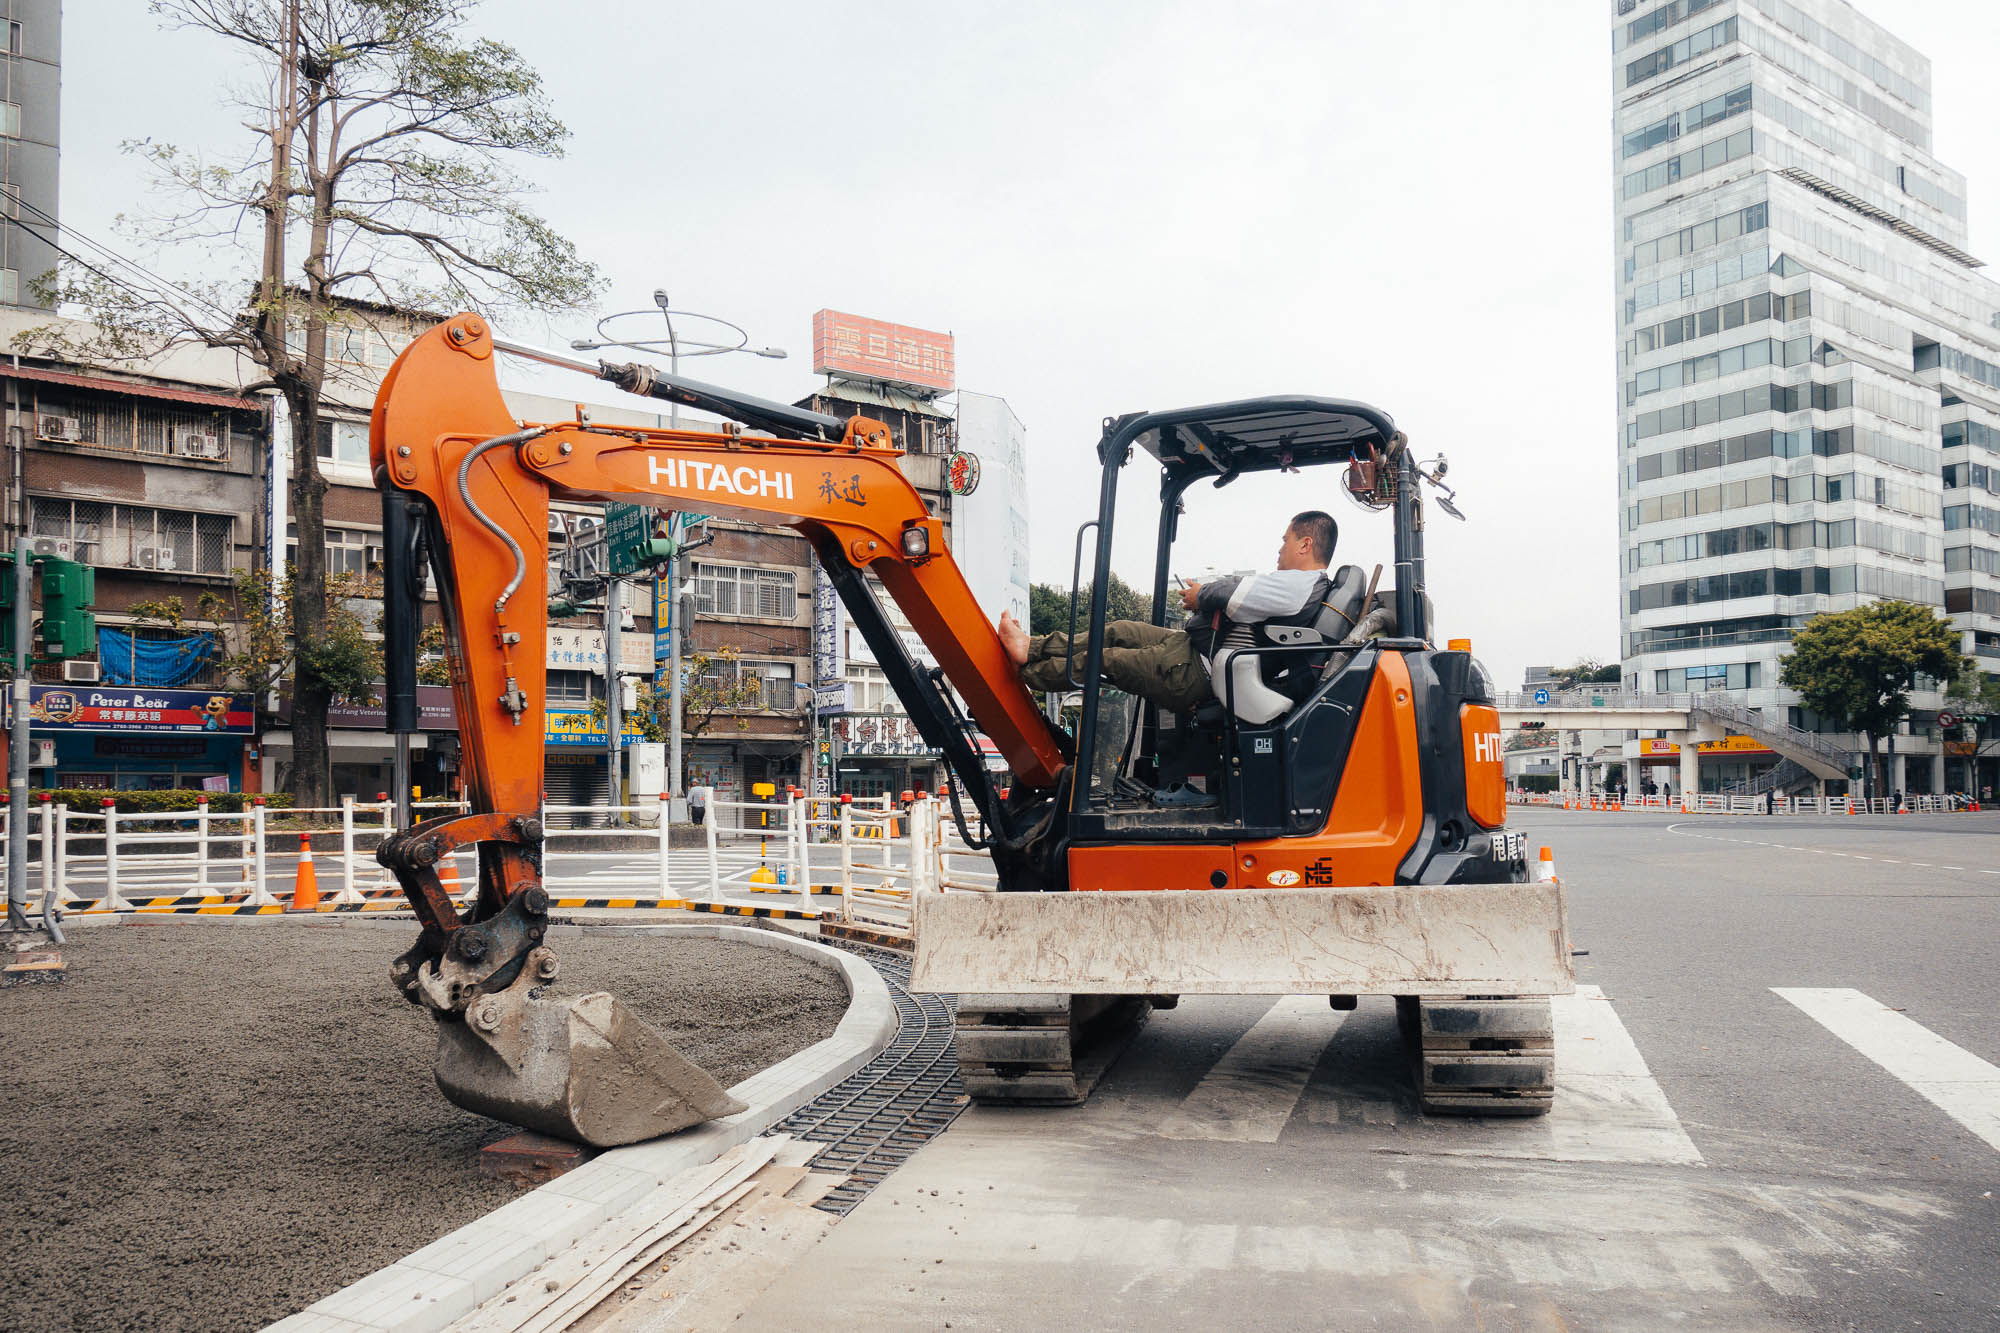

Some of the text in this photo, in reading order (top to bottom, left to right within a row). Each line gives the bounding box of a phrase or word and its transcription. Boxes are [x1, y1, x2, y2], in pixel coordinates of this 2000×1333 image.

[833, 326, 949, 376] 震旦通訊
[648, 456, 794, 500] HITACHI
[89, 693, 129, 708] Peter
[342, 708, 359, 717] Fang
